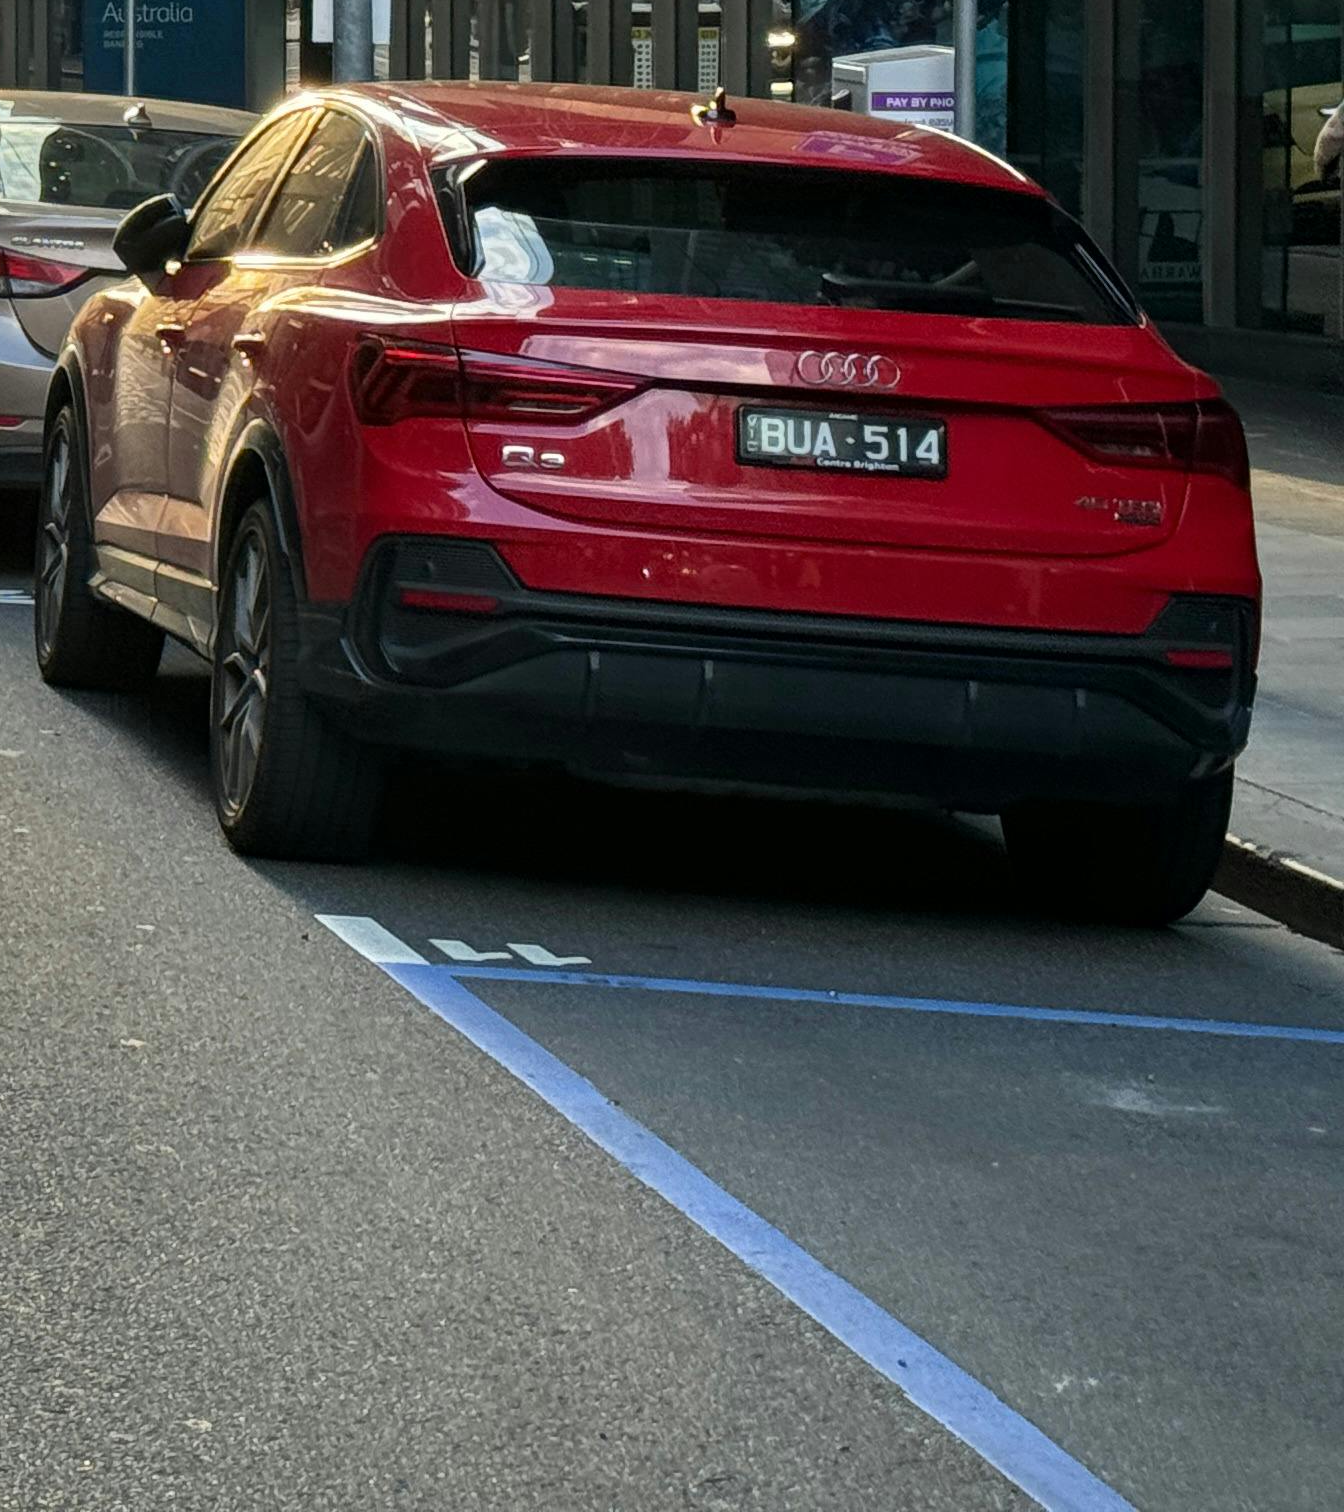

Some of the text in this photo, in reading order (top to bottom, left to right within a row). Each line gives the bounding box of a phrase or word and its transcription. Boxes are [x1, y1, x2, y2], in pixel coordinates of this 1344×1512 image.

[887, 97, 955, 108] PAY BY PHO
[762, 417, 837, 457] BUA
[863, 424, 940, 465] 514
[502, 445, 565, 468] Q3
